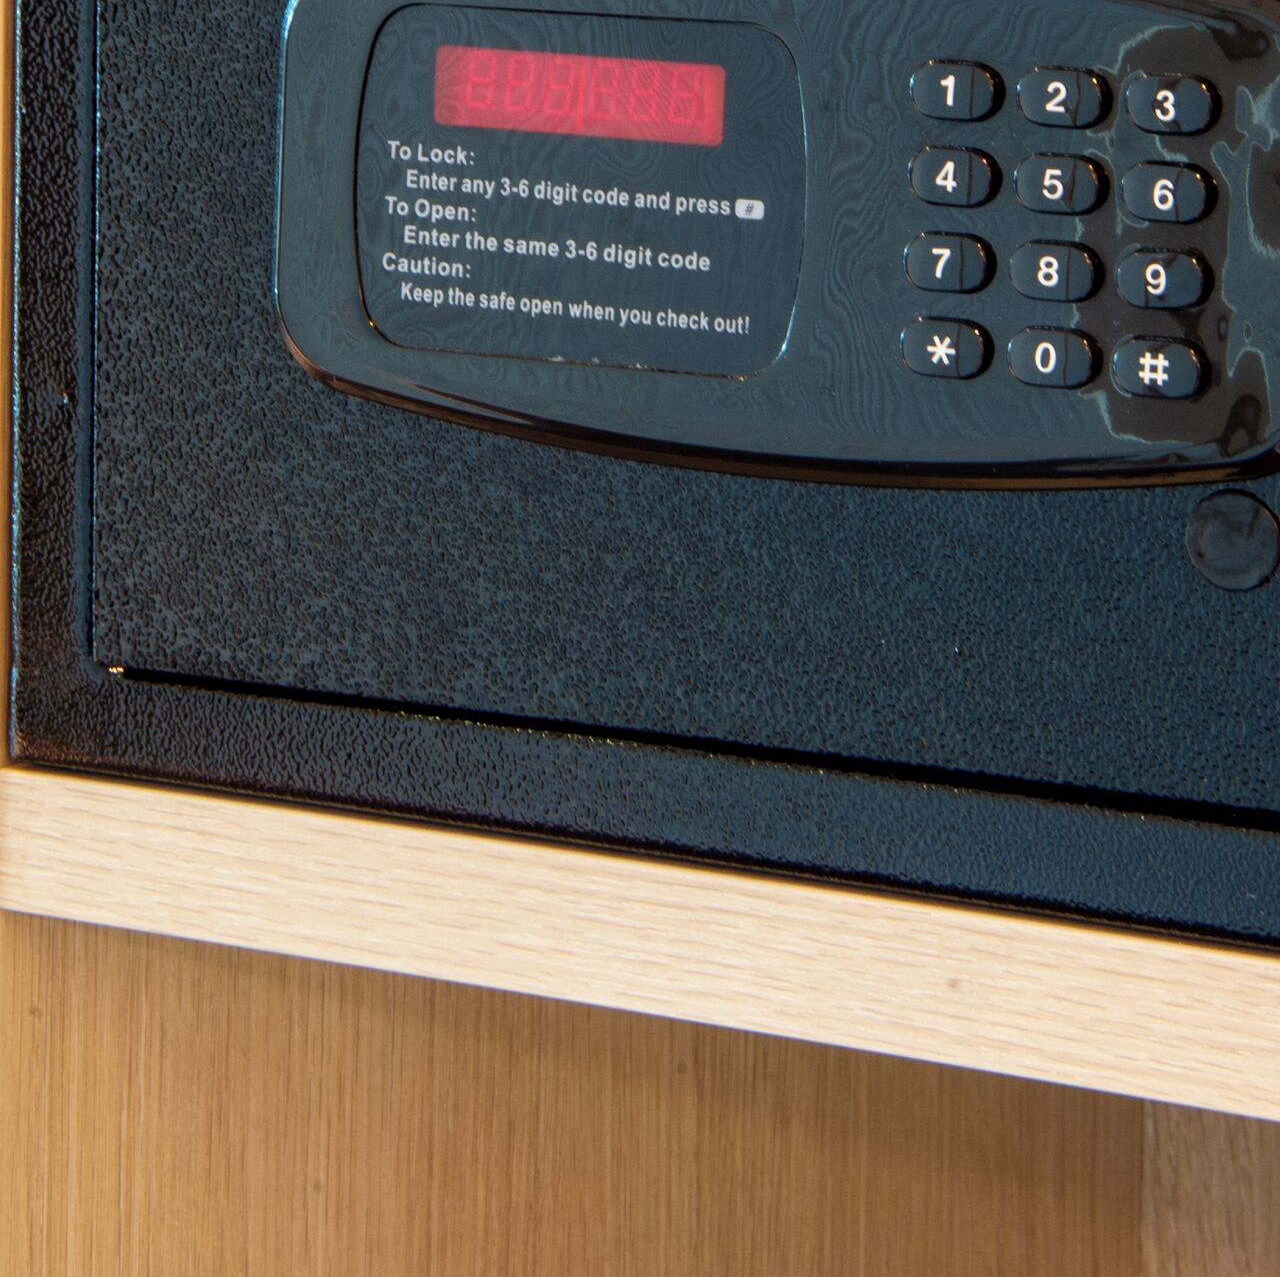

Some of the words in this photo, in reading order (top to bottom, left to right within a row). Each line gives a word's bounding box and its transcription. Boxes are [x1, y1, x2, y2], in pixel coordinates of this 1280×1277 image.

[940, 75, 956, 107] 1
[1045, 81, 1067, 113] 2
[1155, 90, 1176, 122] 3
[388, 140, 412, 160] To
[418, 144, 475, 165] Lock:
[406, 169, 457, 191] Enter
[461, 179, 495, 199] any
[500, 178, 529, 198] 3-6
[534, 181, 578, 205] digit
[582, 187, 630, 207] code
[634, 191, 670, 211] and
[675, 197, 731, 216] press
[935, 161, 957, 193] 4
[1042, 169, 1064, 200] 5
[385, 195, 409, 216] To
[415, 198, 476, 222] Open:
[1153, 179, 1175, 211] 6
[404, 225, 460, 248] Enter
[465, 231, 498, 252] the
[503, 238, 560, 258] same
[565, 239, 598, 261] 3-6
[603, 243, 652, 269] digit
[657, 251, 711, 271] code
[931, 248, 952, 279] 7
[382, 252, 471, 278] Caution:
[1036, 256, 1059, 287] 8
[1145, 263, 1167, 296] 9
[401, 282, 444, 308] Keep
[448, 287, 475, 307] the
[479, 292, 516, 311] safe
[520, 298, 563, 318] open
[569, 300, 615, 322] when
[619, 308, 652, 328] you
[656, 309, 709, 331] check
[714, 316, 750, 334] out!
[1034, 342, 1057, 373] 0
[1138, 352, 1169, 386] #
